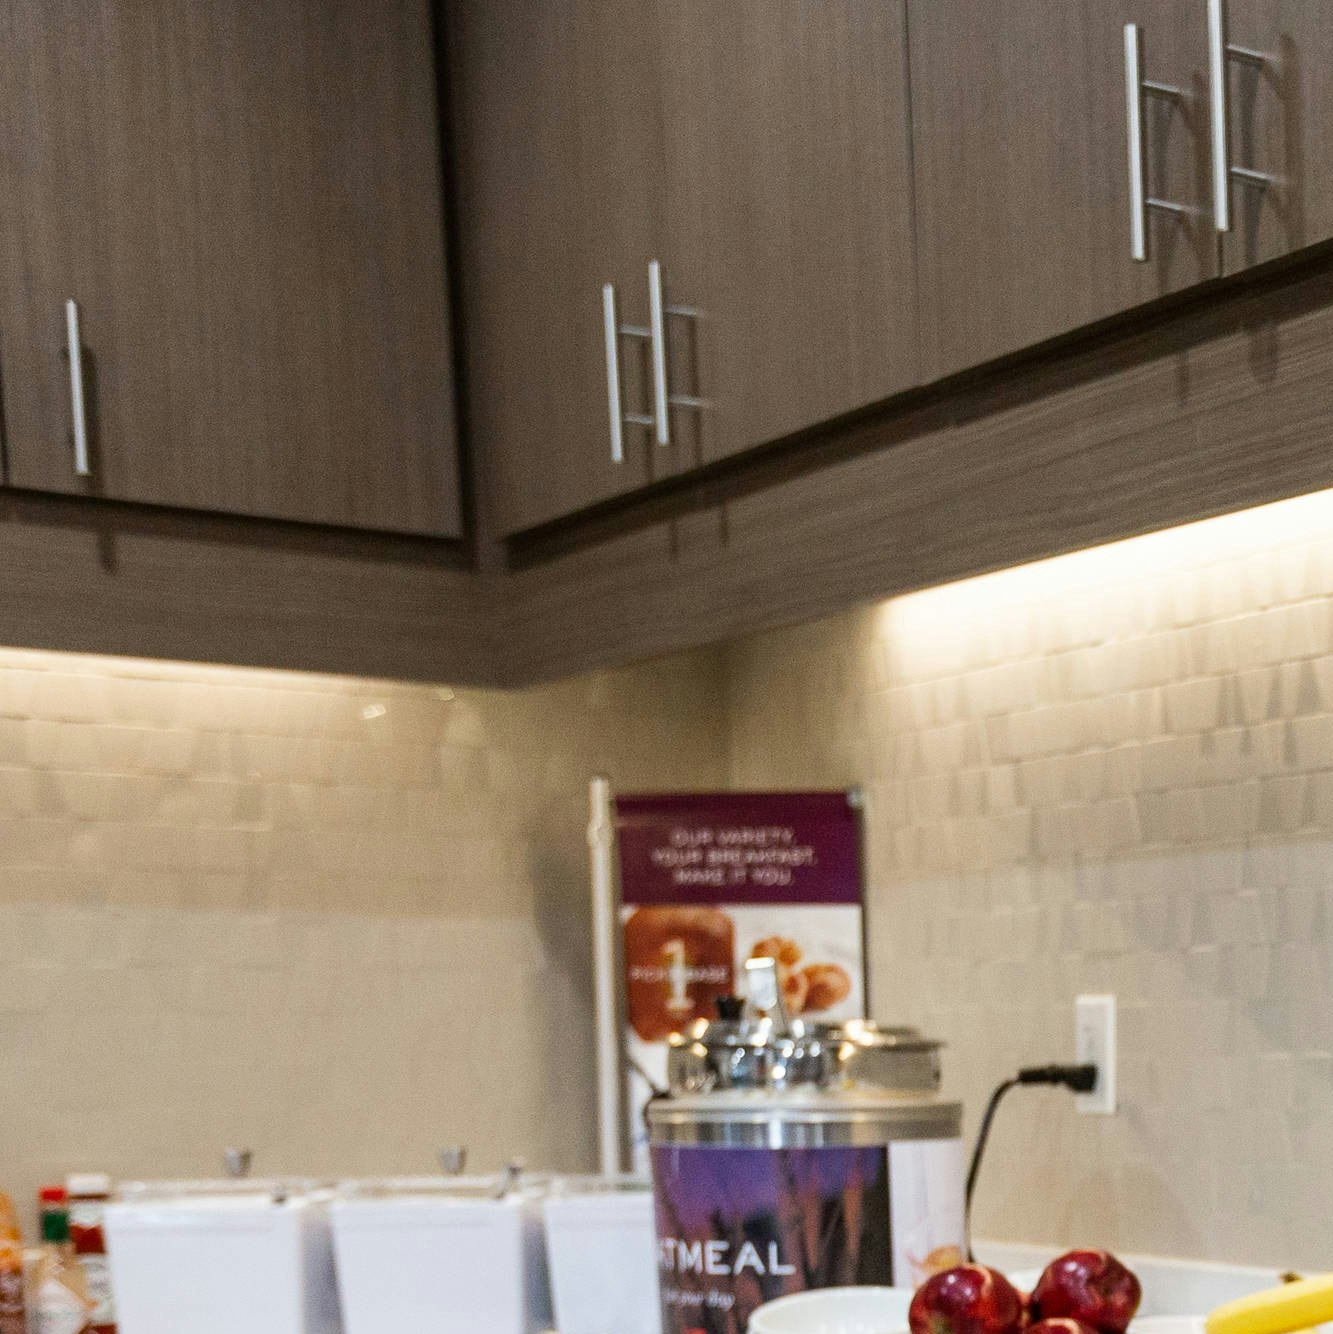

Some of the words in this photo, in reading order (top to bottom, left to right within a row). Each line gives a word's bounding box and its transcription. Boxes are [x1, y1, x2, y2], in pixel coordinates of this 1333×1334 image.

[671, 828, 714, 848] OUR
[652, 847, 703, 867] YOUR
[674, 867, 726, 886] MAKE
[660, 939, 697, 1012] 1
[658, 1238, 797, 1276] TMEAL
